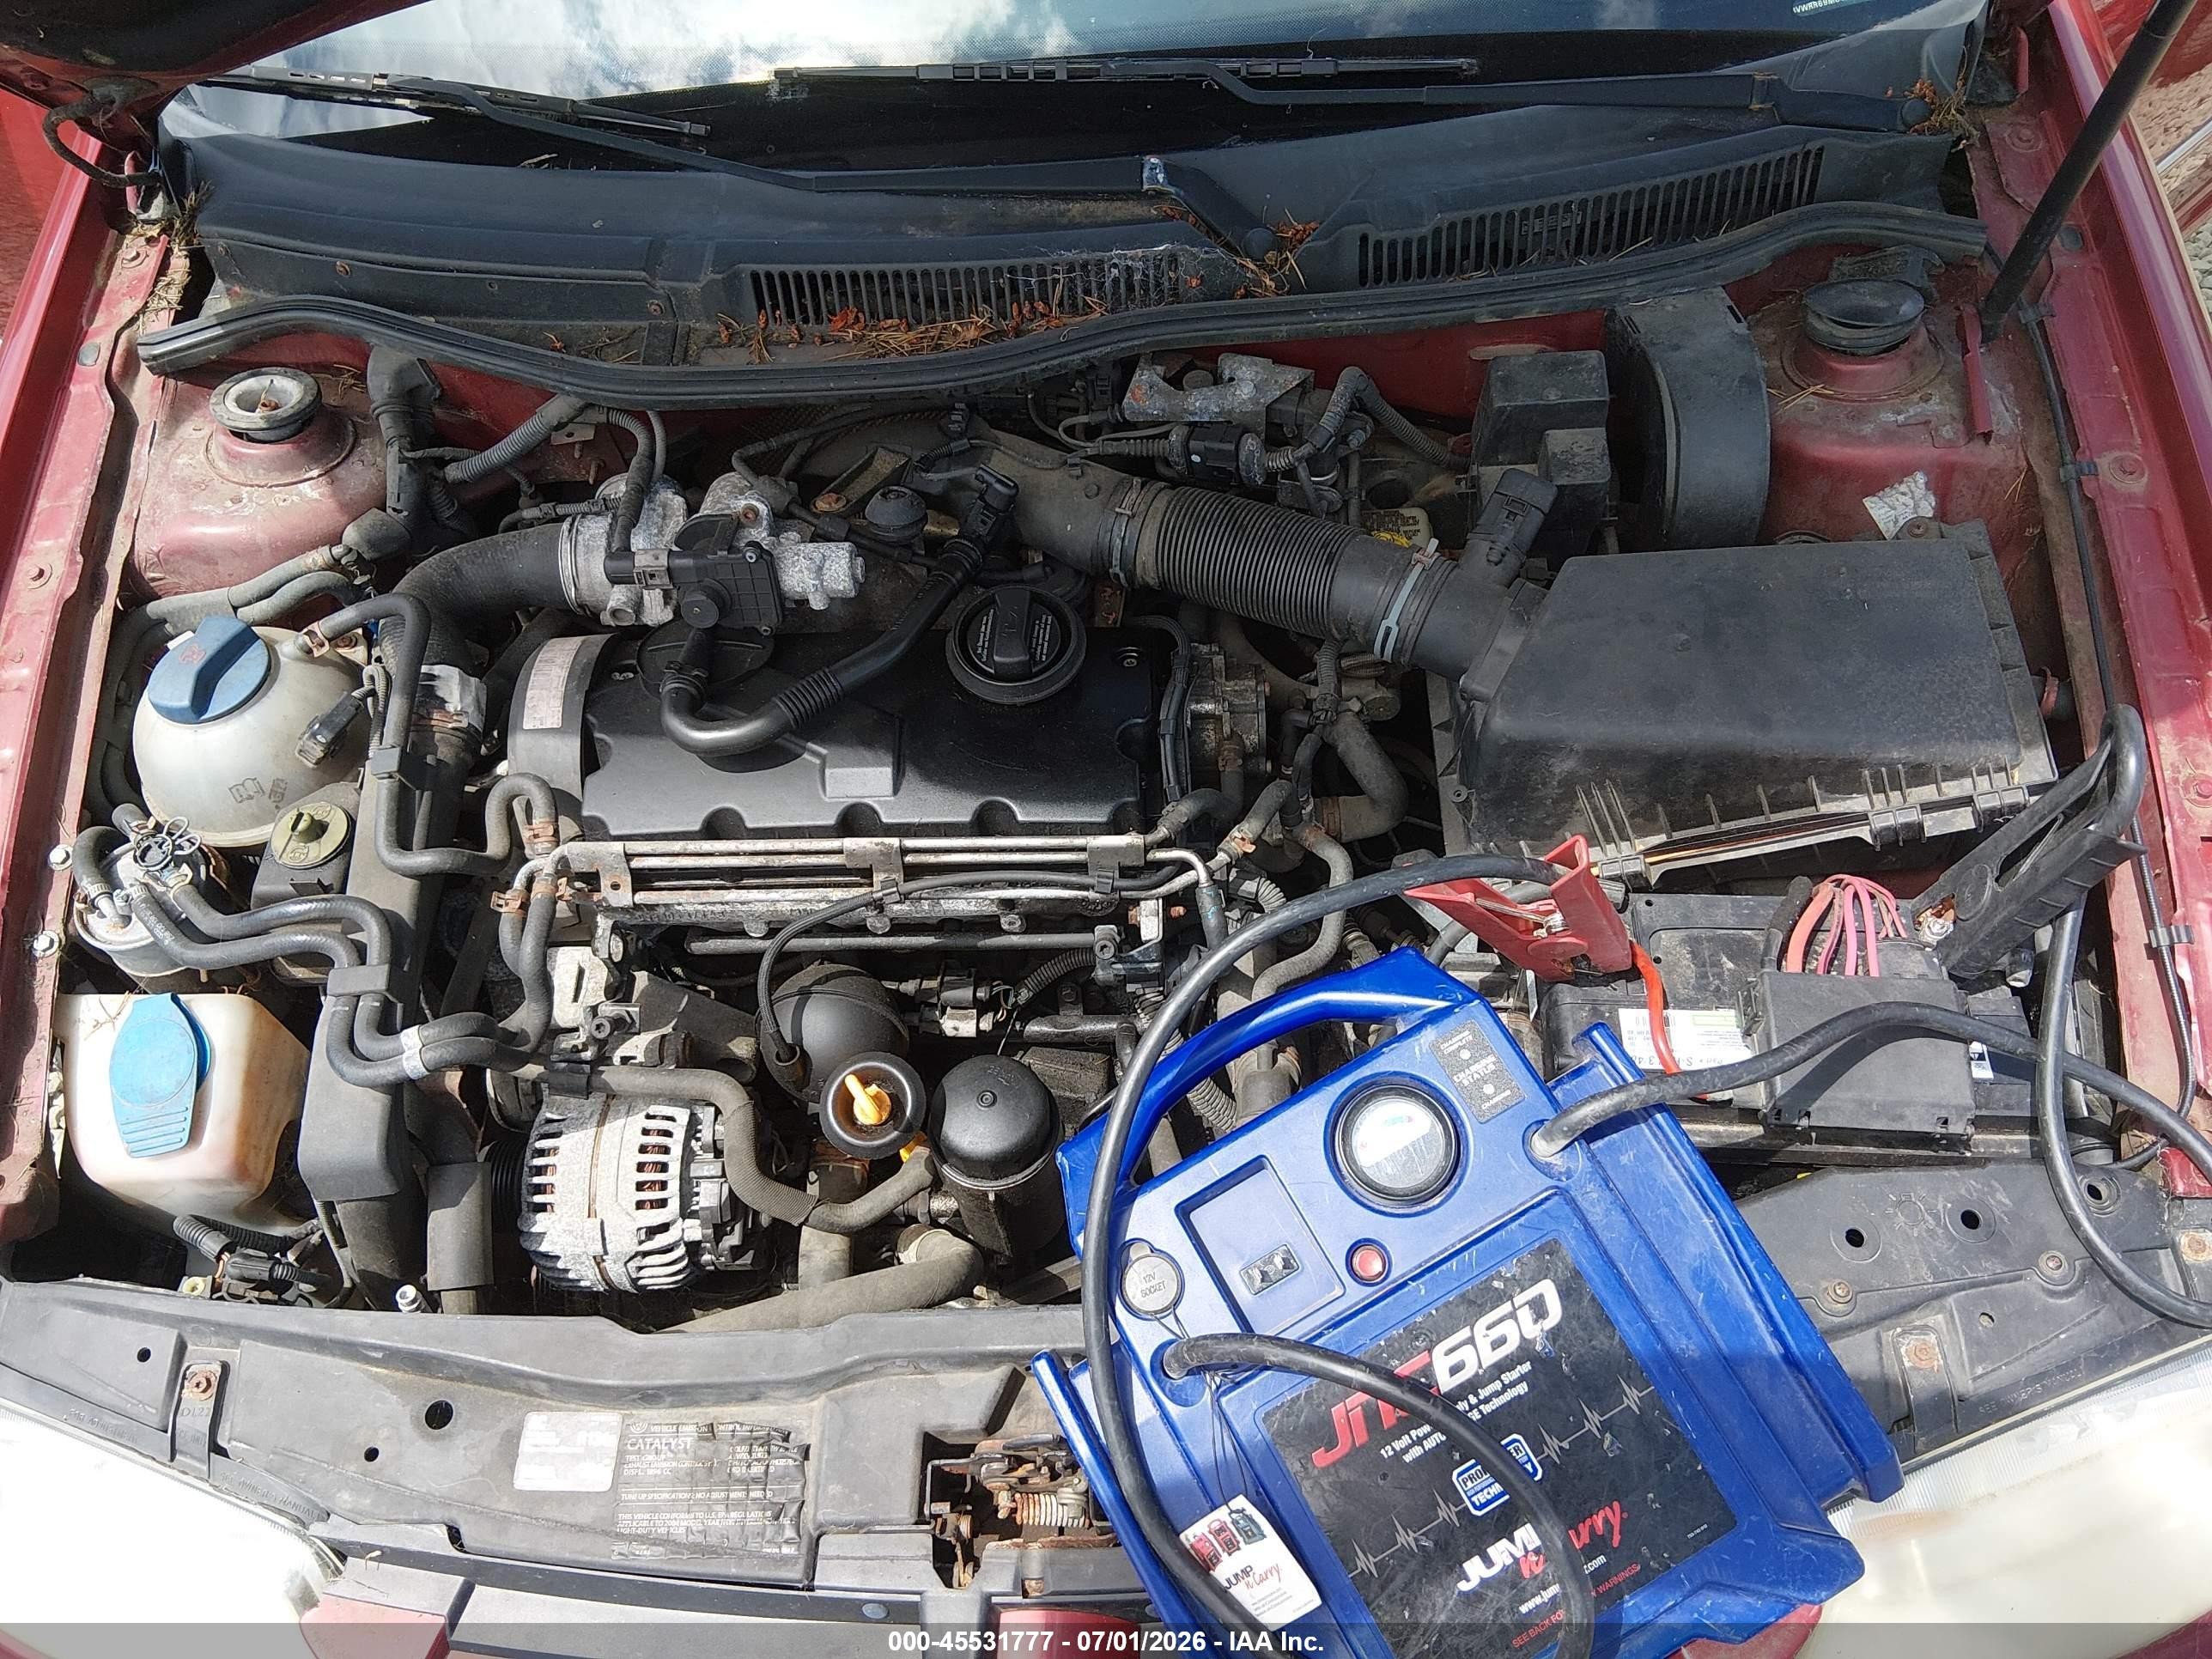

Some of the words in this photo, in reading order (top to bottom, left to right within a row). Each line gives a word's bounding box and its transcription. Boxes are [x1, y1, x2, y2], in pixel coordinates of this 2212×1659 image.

[1462, 1064, 1496, 1086] STATUS
[1140, 1280, 1166, 1298] SOCKET
[1143, 1271, 1156, 1284] 12V
[1379, 1443, 1394, 1459] 12
[1393, 1429, 1413, 1452] Volt
[1410, 1422, 1433, 1442] Pow
[1468, 1392, 1479, 1407] &
[1477, 1378, 1503, 1407] Jump
[1500, 1360, 1533, 1385] Starter
[1402, 1445, 1423, 1464] with
[1478, 1382, 1529, 1419] Technology
[626, 1437, 694, 1451] CATALYST
[1224, 1565, 1254, 1590] JUMP
[1512, 1636, 1529, 1649] SEE
[1528, 1620, 1551, 1638] BACK
[1596, 1563, 1639, 1594] WARNINGS
